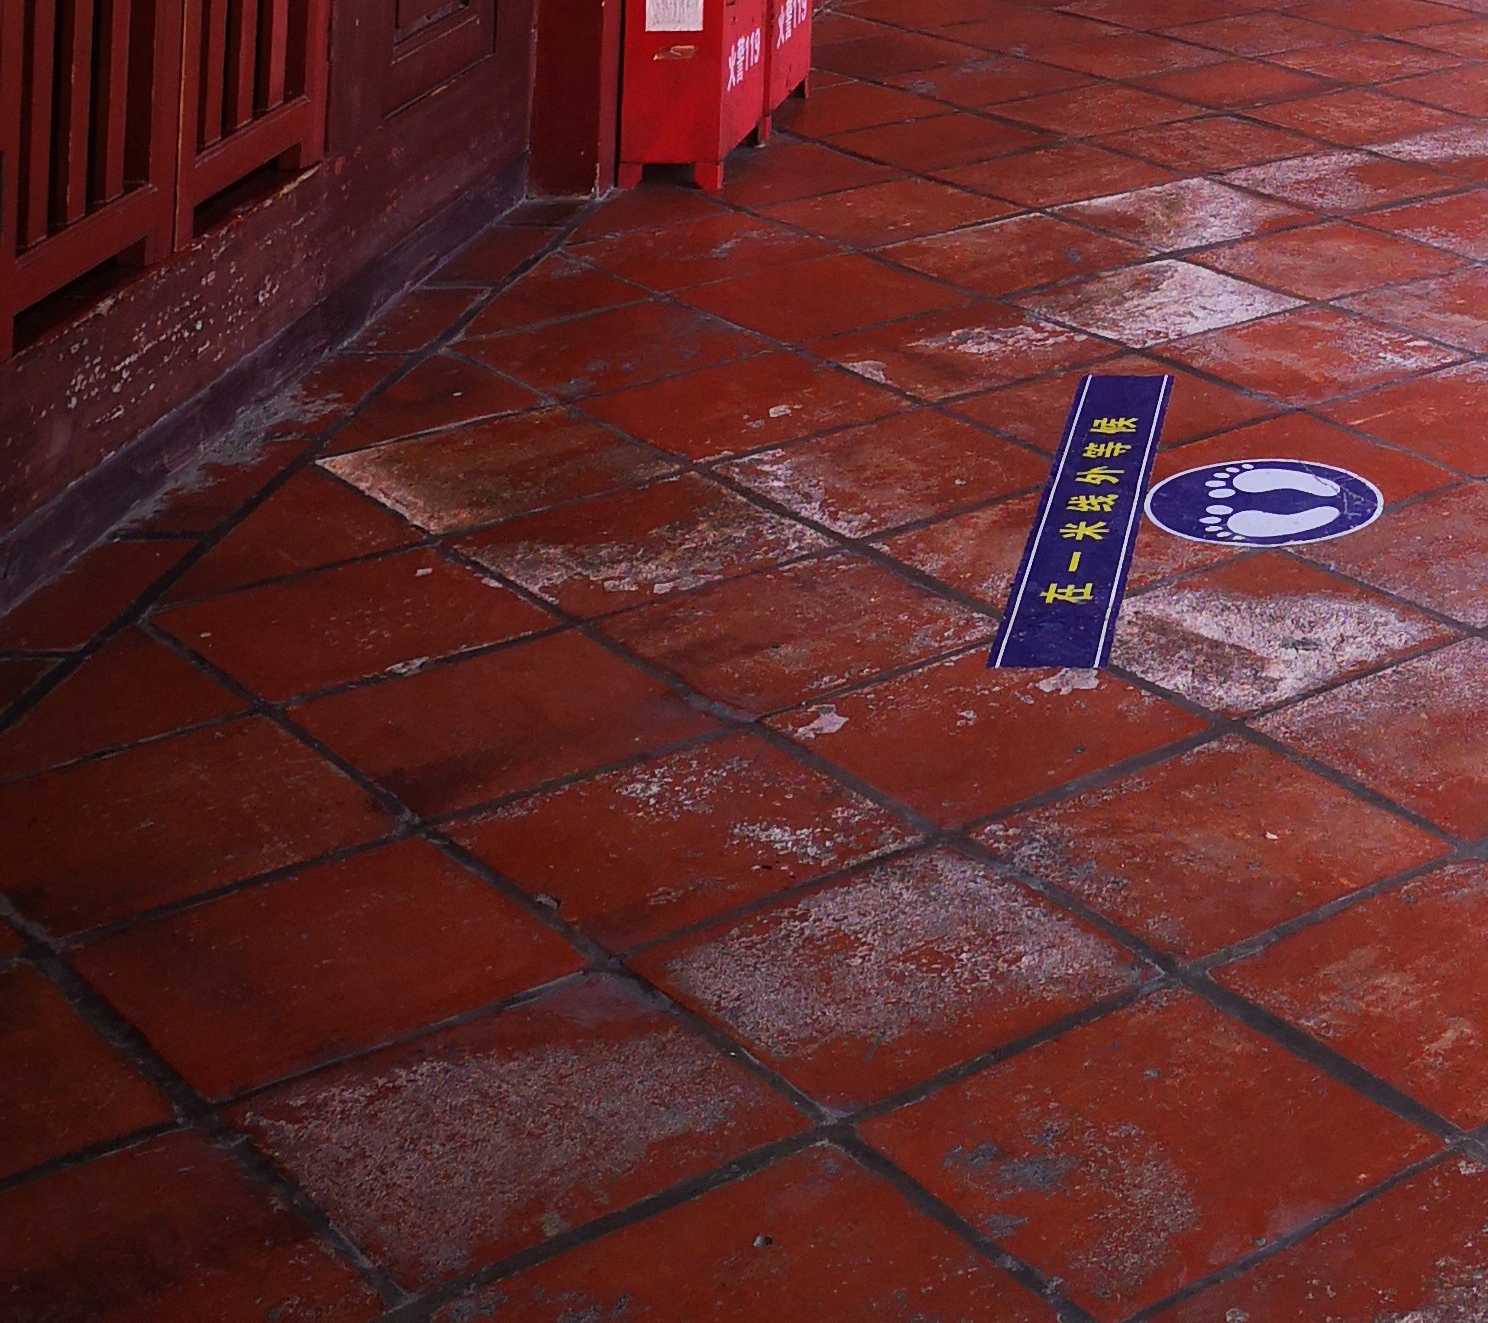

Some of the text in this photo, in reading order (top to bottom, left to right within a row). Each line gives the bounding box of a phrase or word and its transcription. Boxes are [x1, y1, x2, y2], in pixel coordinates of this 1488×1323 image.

[726, 26, 761, 93] 火警119
[1039, 415, 1139, 605] 在一米线外等候
